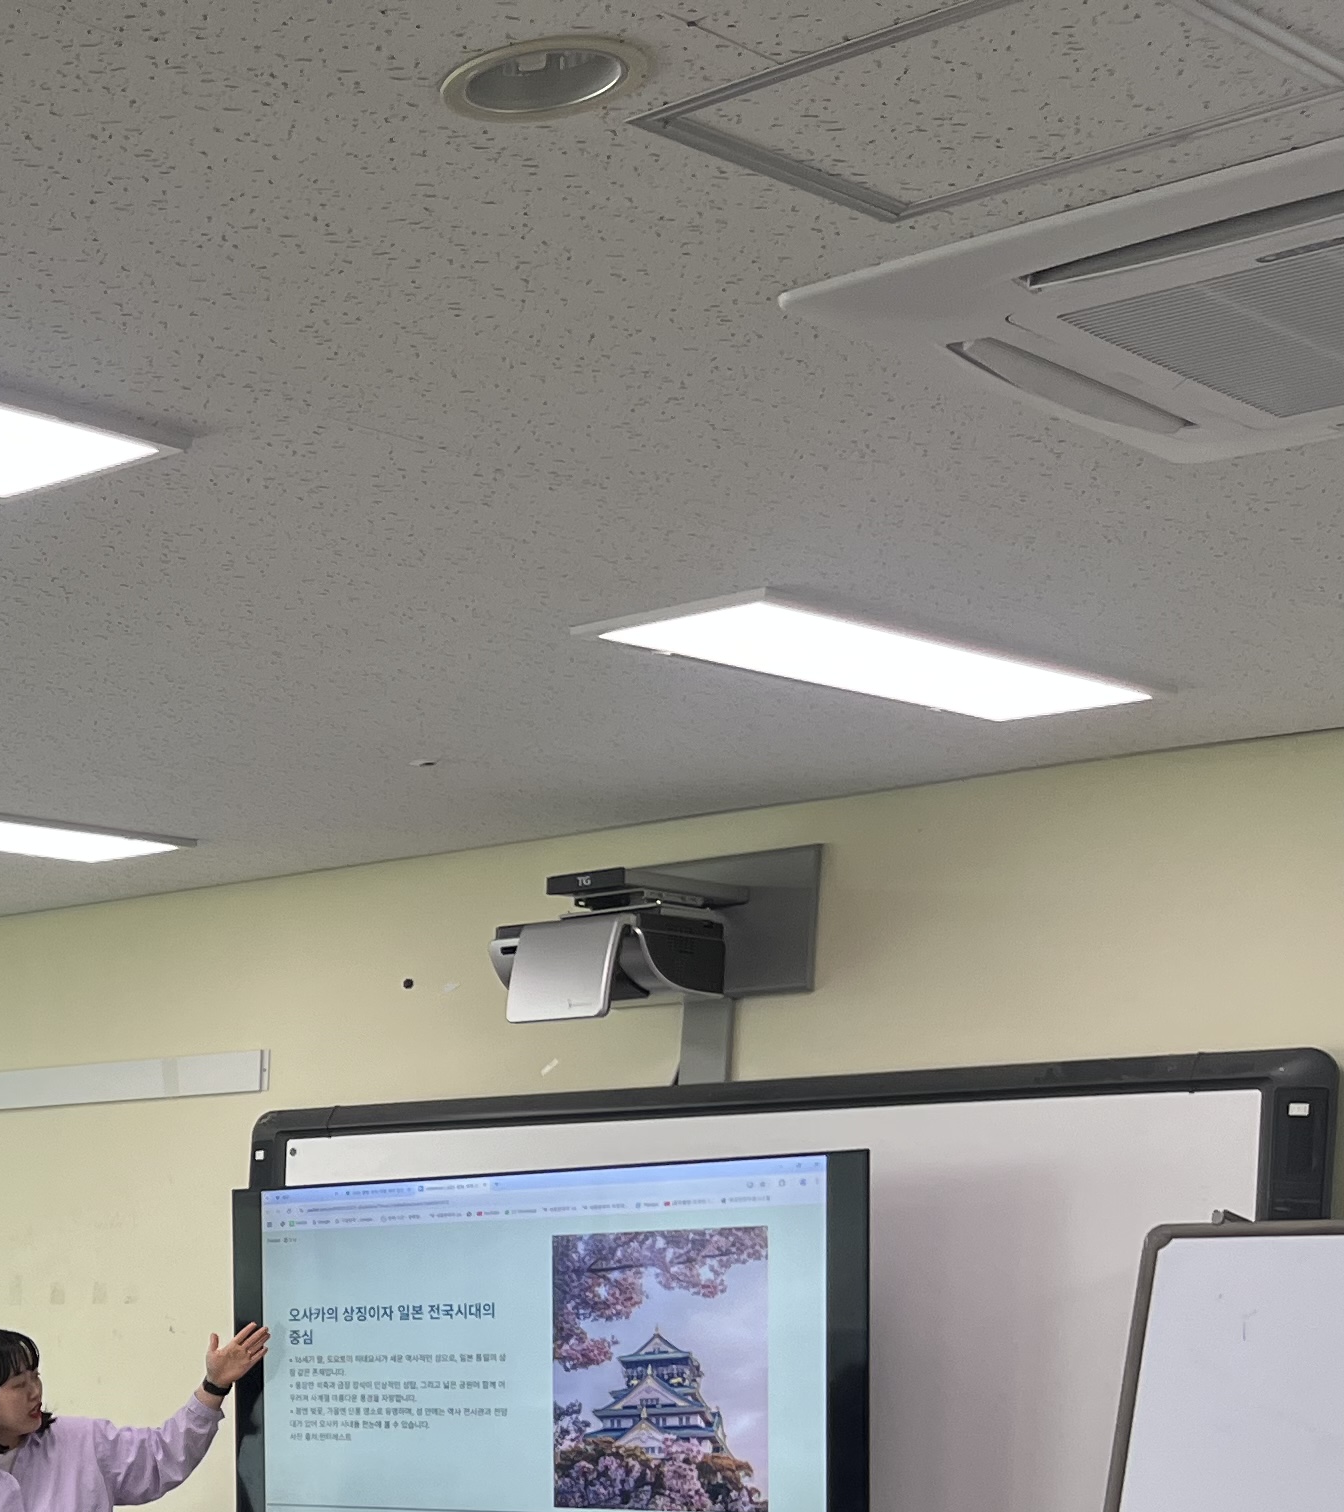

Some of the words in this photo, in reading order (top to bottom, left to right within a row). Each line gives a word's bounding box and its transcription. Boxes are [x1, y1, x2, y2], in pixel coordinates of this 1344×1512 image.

[577, 875, 591, 887] TG
[288, 1306, 338, 1323] 오사카의
[342, 1304, 394, 1322] 상징이자
[398, 1304, 424, 1321] 일본
[428, 1302, 496, 1320] 전국시대의
[288, 1329, 313, 1345] 중심
